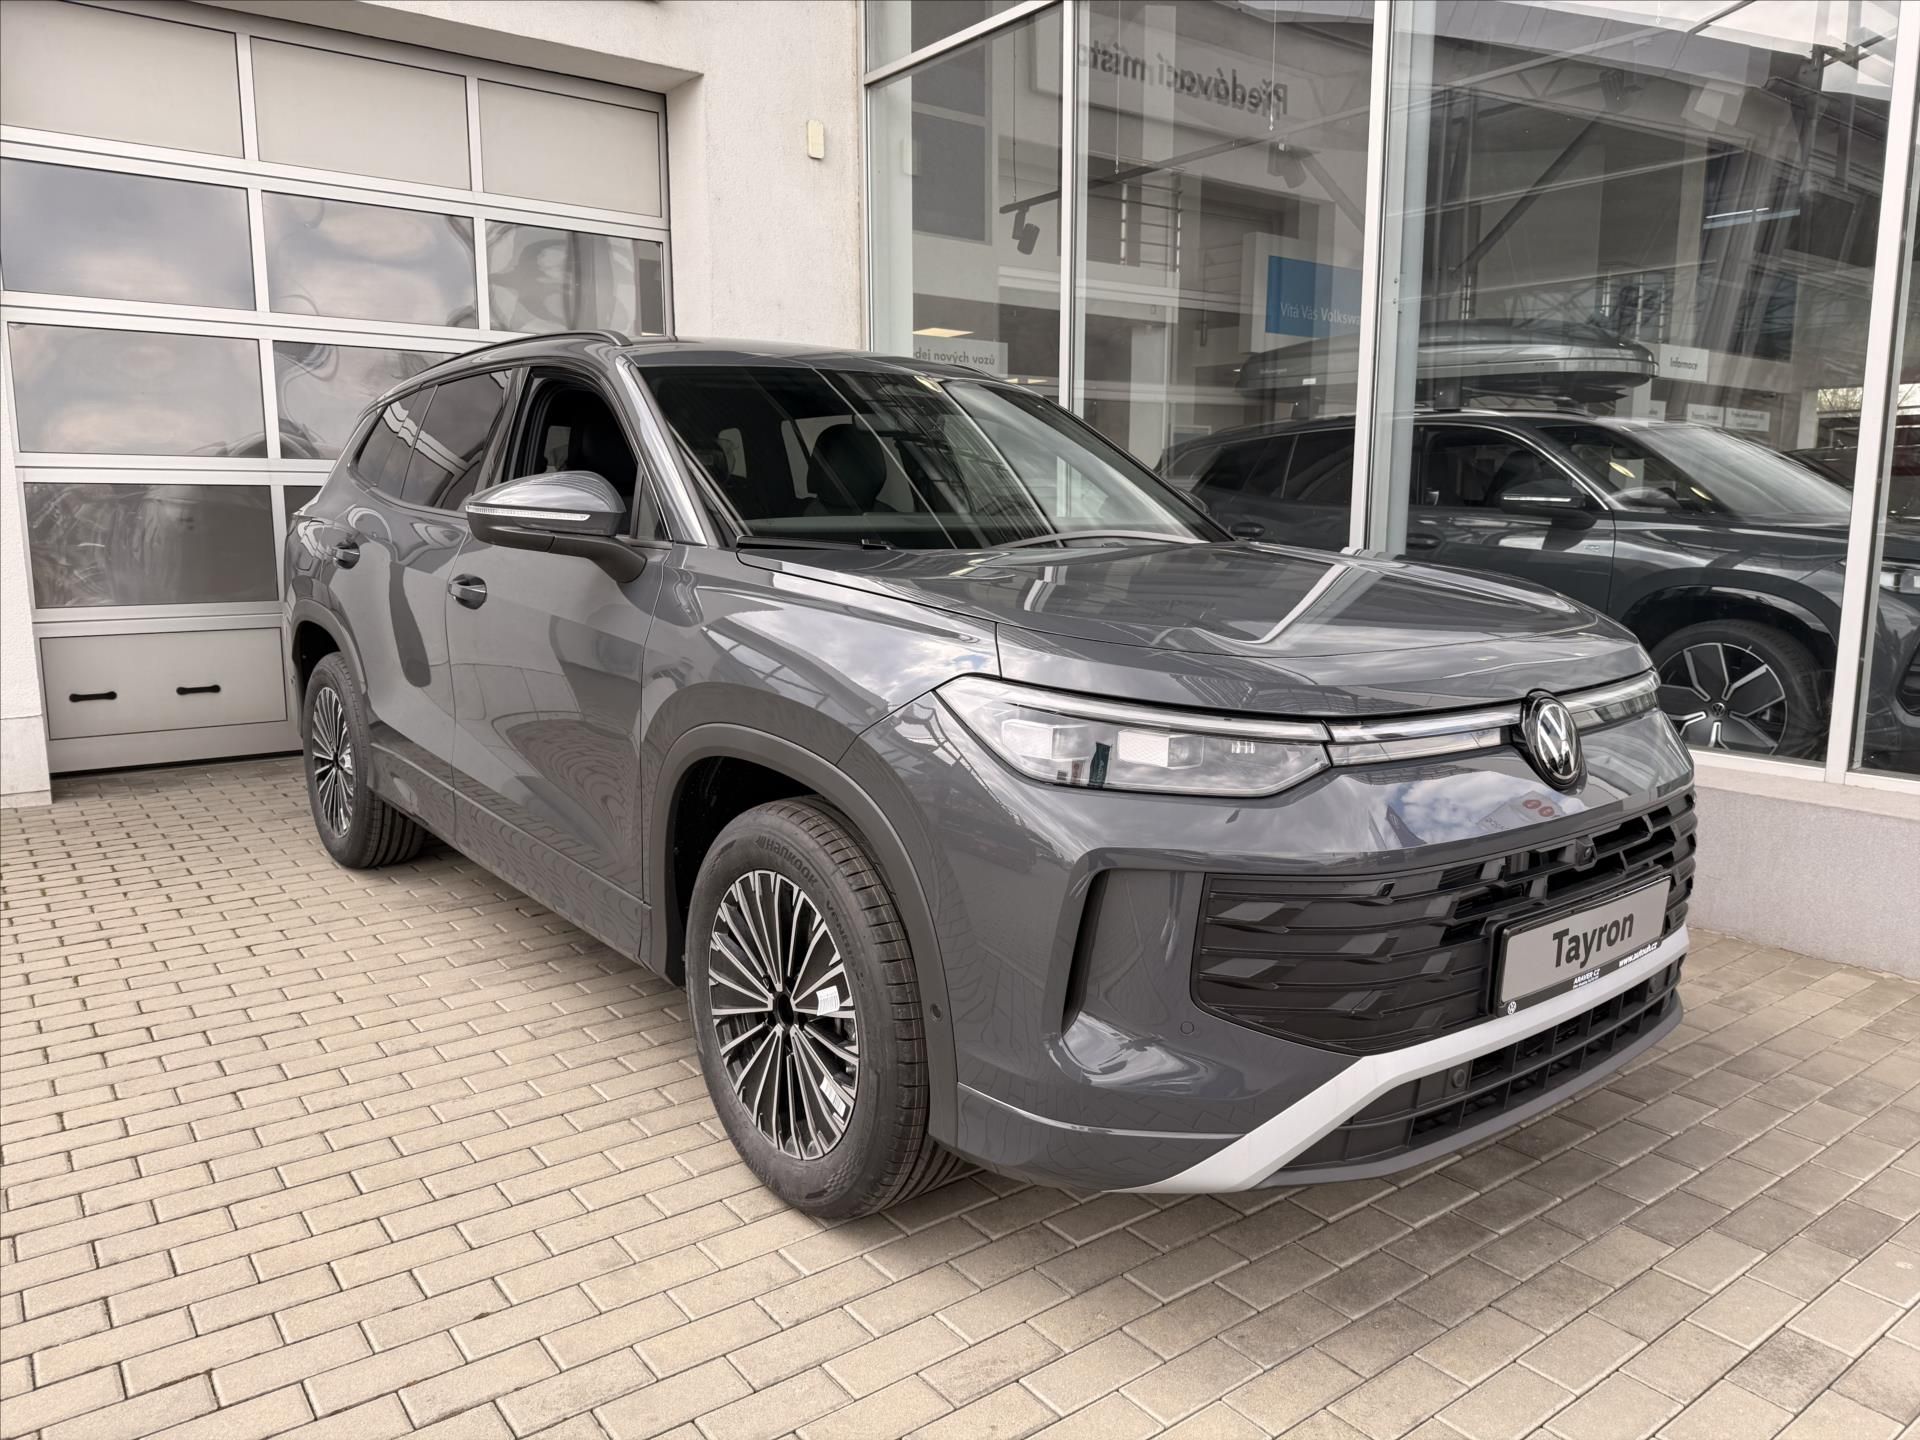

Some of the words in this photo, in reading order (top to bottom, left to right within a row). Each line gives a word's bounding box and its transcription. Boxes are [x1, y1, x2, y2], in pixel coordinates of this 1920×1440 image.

[934, 351, 969, 364] nových
[972, 353, 996, 366] vozů
[1552, 913, 1634, 969] Tayron
